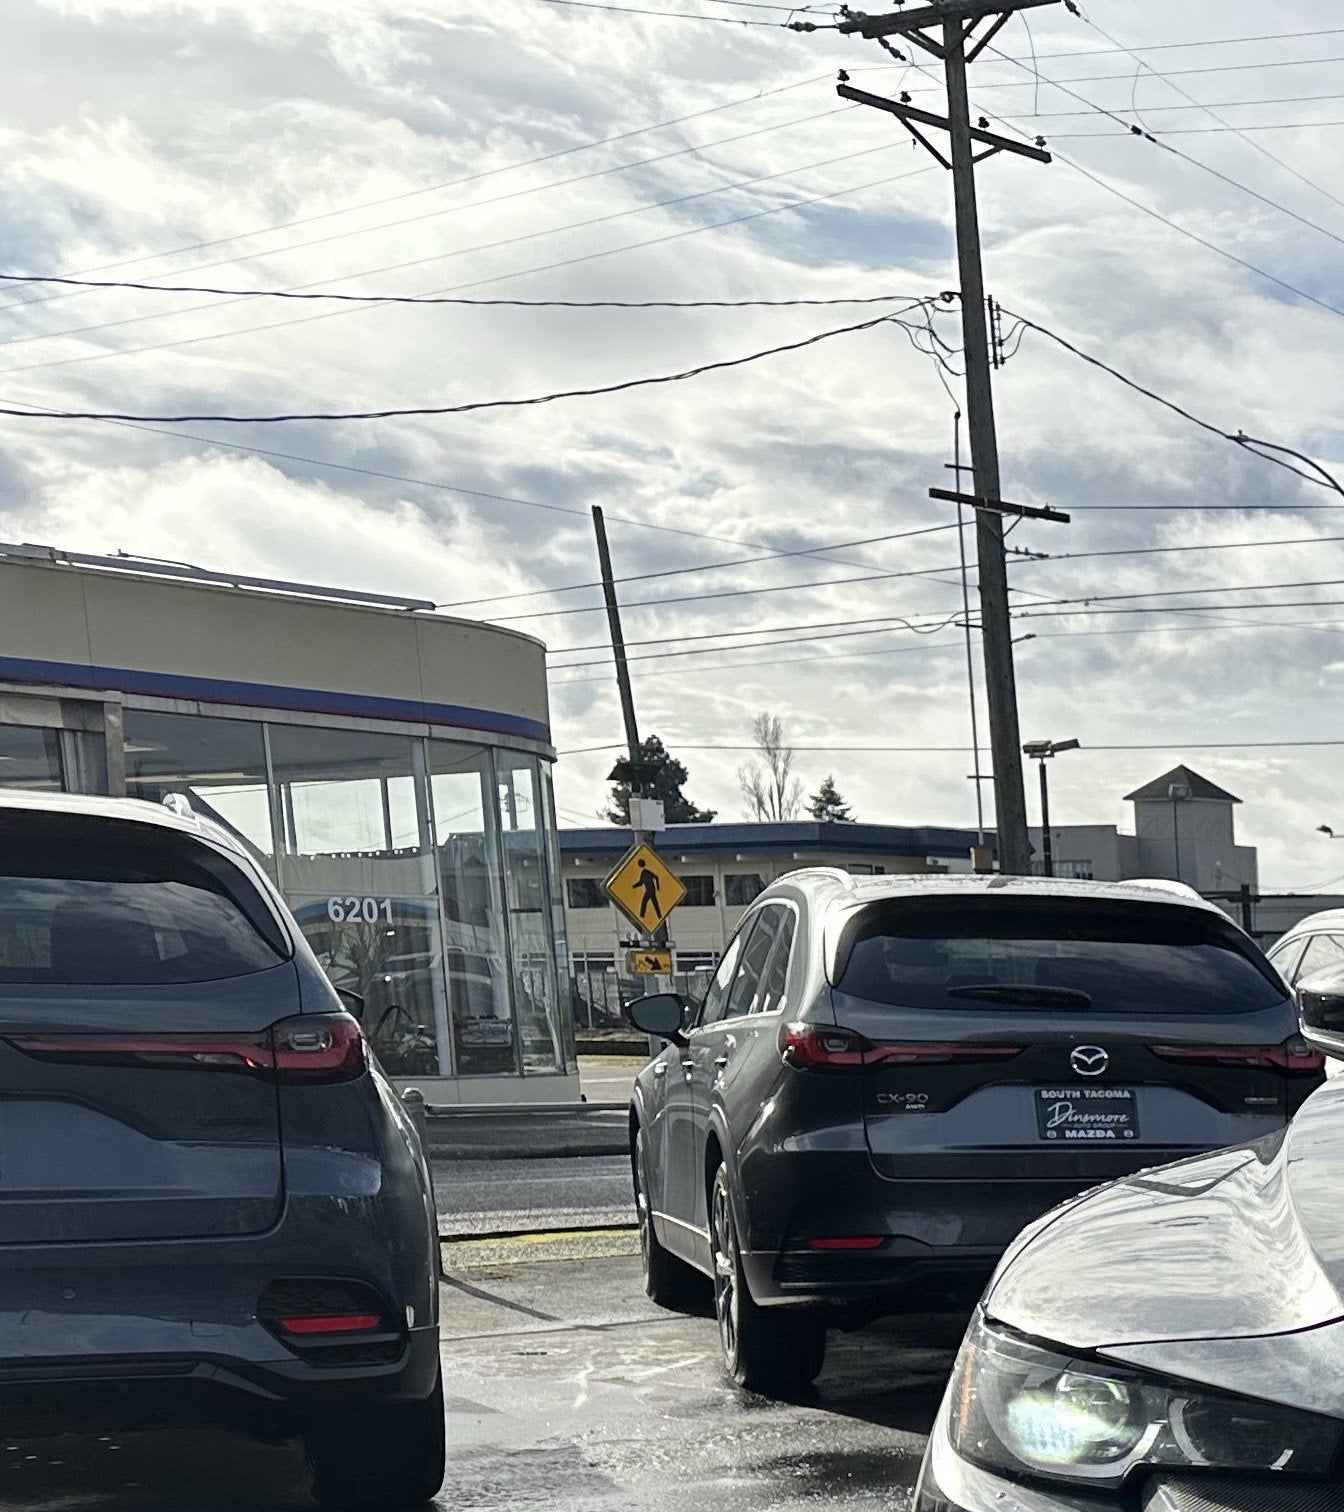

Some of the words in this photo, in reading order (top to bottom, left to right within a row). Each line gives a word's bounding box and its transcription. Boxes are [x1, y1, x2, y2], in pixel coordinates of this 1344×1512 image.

[328, 896, 393, 924] 6201
[876, 1093, 929, 1104] CX-90
[1041, 1089, 1080, 1099] SOUTH
[1083, 1089, 1130, 1099] TACOMA
[1065, 1129, 1116, 1139] MAZDA
